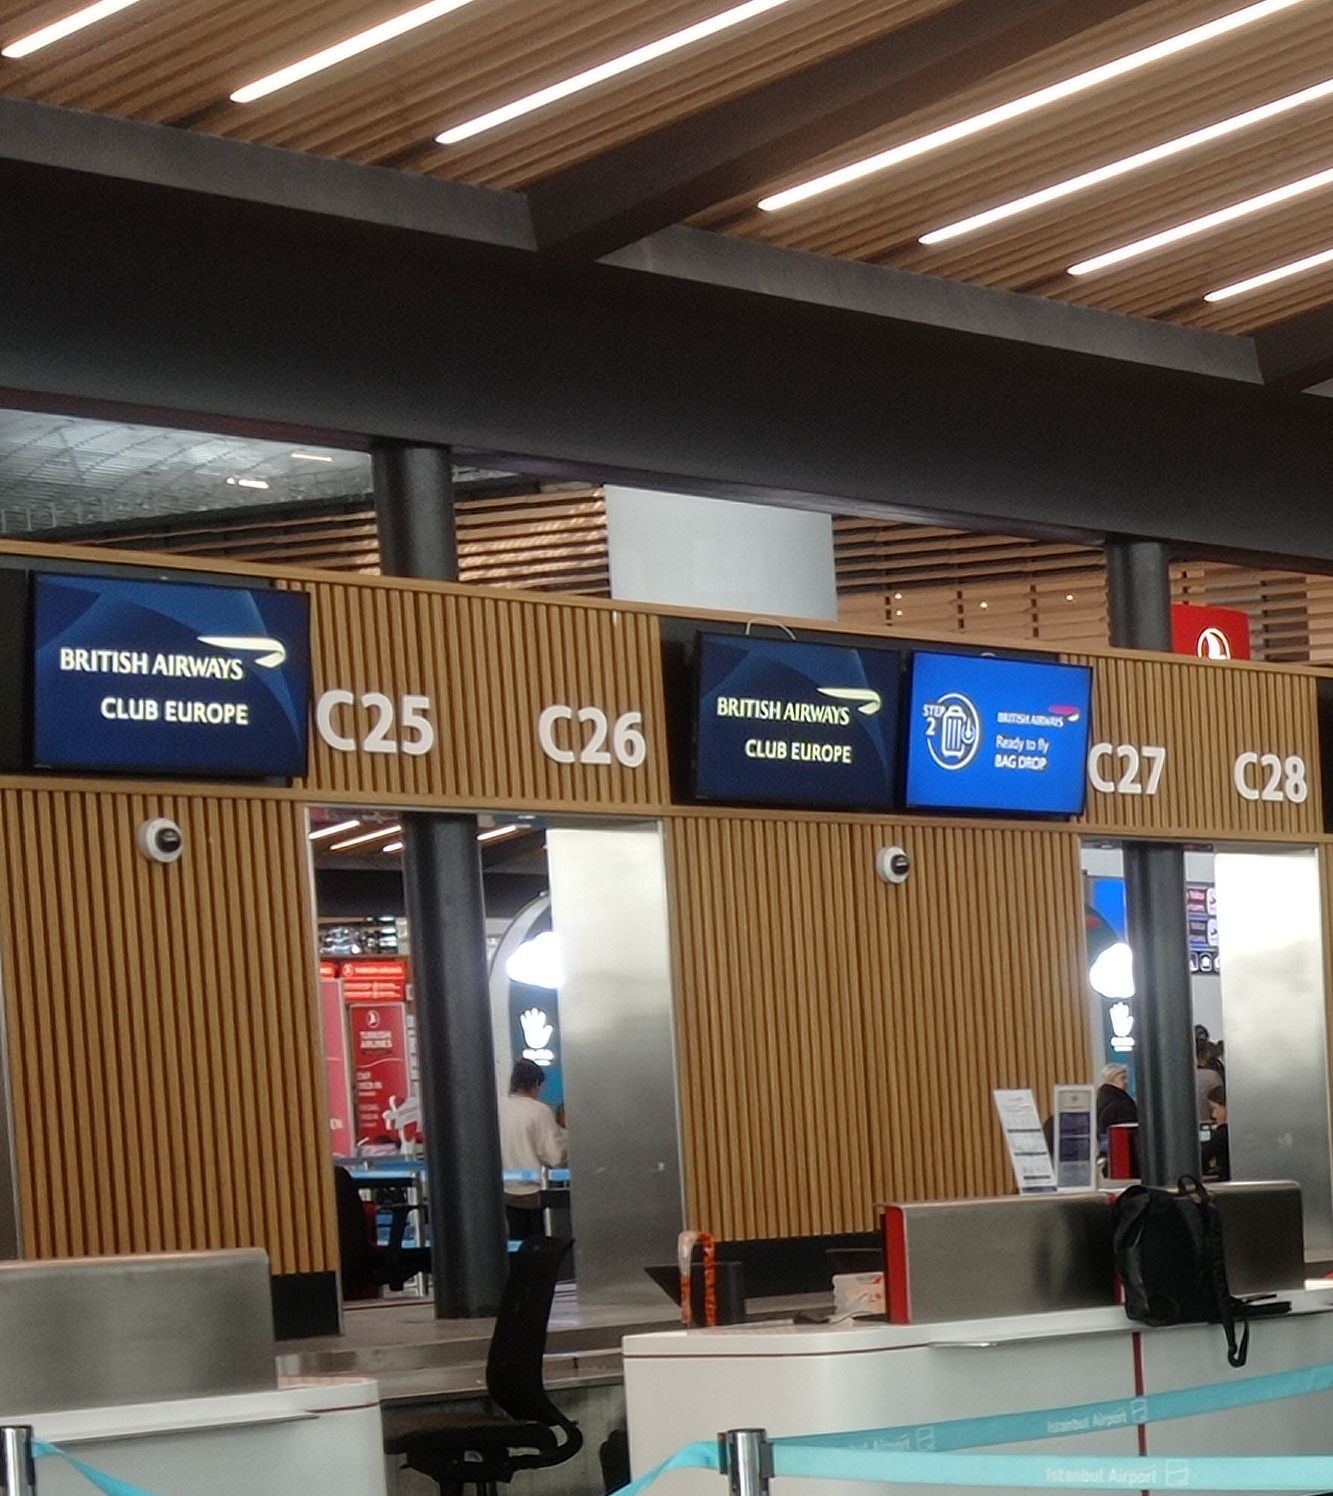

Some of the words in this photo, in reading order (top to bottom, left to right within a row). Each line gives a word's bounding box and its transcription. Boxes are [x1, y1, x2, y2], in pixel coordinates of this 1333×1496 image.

[60, 647, 149, 675] BRITISH
[151, 654, 244, 680] AIRWAYS
[101, 696, 159, 721] CLUB
[165, 700, 249, 726] EUROPE
[316, 688, 435, 756] C25
[717, 697, 781, 720] BRITISH
[783, 702, 850, 725] AIRWAYS
[922, 704, 946, 717] STEP
[538, 705, 647, 768] C26
[926, 718, 936, 736] 2
[745, 739, 787, 759] CLUB
[791, 742, 852, 763] EUROPE
[996, 735, 1025, 753] Ready
[1026, 738, 1036, 750] to
[995, 755, 1017, 769] BAG
[1018, 756, 1047, 770] DROP
[1088, 743, 1166, 795] C27
[1234, 752, 1308, 803] C28
